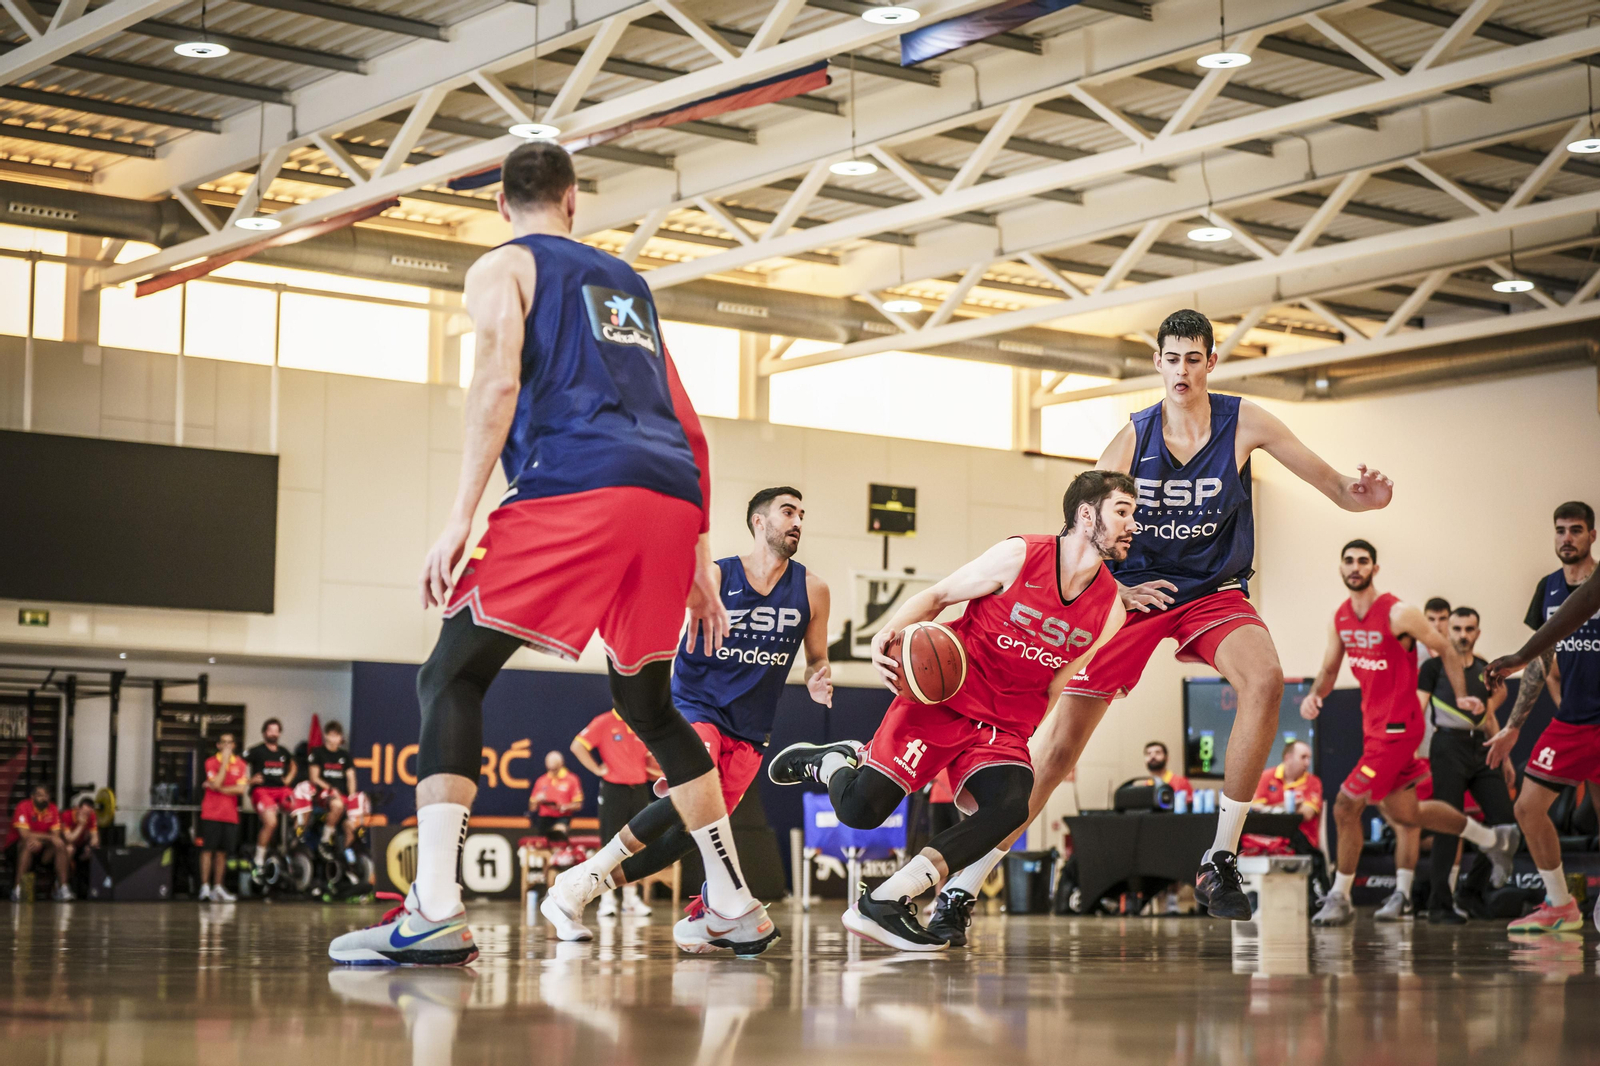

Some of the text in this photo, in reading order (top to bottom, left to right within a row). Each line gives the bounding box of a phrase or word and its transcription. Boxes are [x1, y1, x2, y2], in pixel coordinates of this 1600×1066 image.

[1134, 477, 1223, 507] ESP
[1138, 508, 1222, 516] ASKETBALL
[1132, 520, 1218, 540] endesa
[726, 606, 802, 633] ESP
[1009, 601, 1093, 652] ESP
[1340, 629, 1383, 649] ESP
[716, 646, 790, 666] endesa
[893, 755, 917, 779] network
